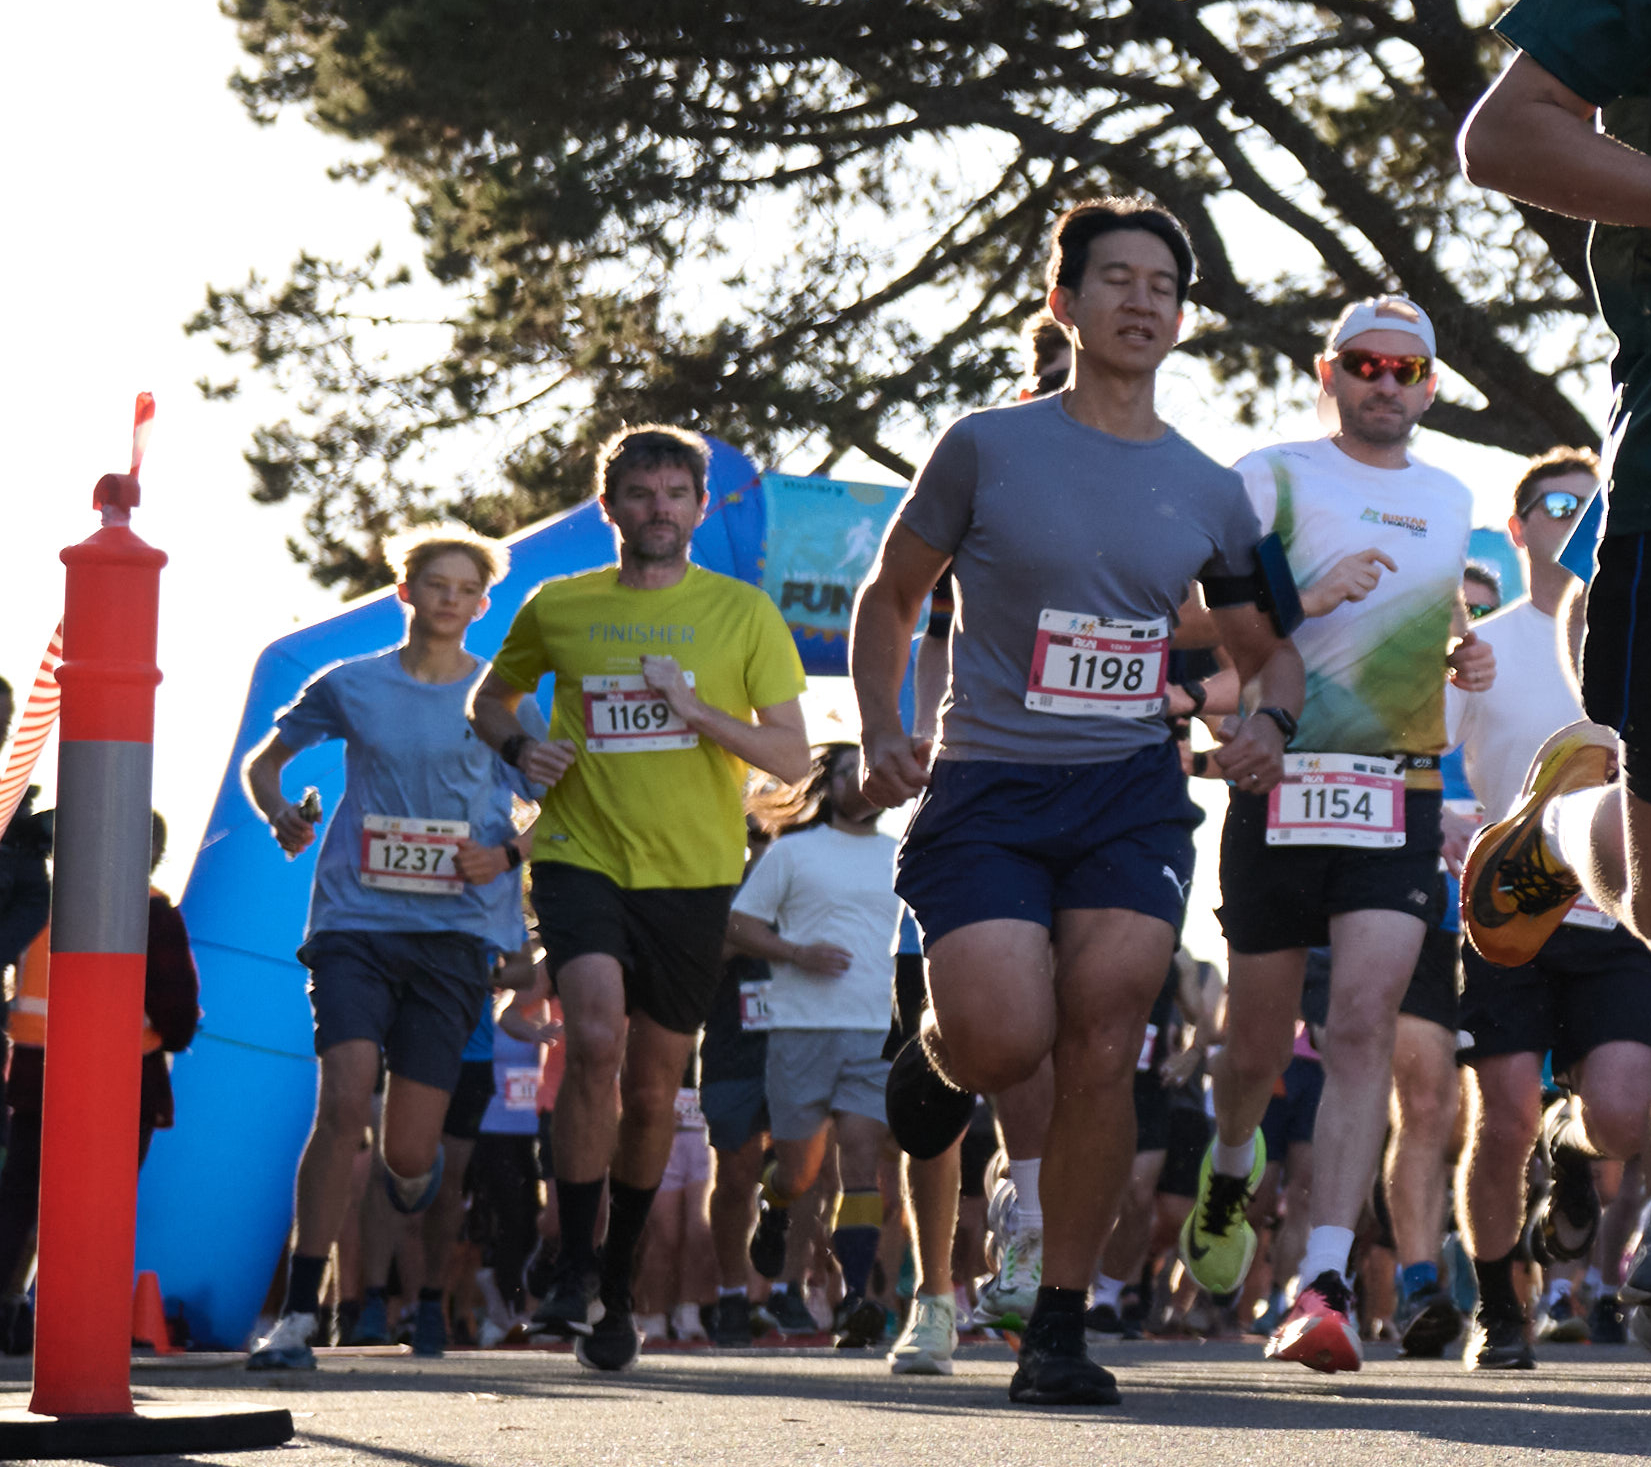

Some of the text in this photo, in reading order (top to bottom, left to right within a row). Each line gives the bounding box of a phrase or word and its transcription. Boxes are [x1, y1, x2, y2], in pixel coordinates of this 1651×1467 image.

[588, 622, 696, 645] FINISHER
[1069, 653, 1145, 692] 1198
[608, 702, 669, 731] 1169
[1302, 788, 1374, 822] 1154
[383, 844, 445, 873] 1237
